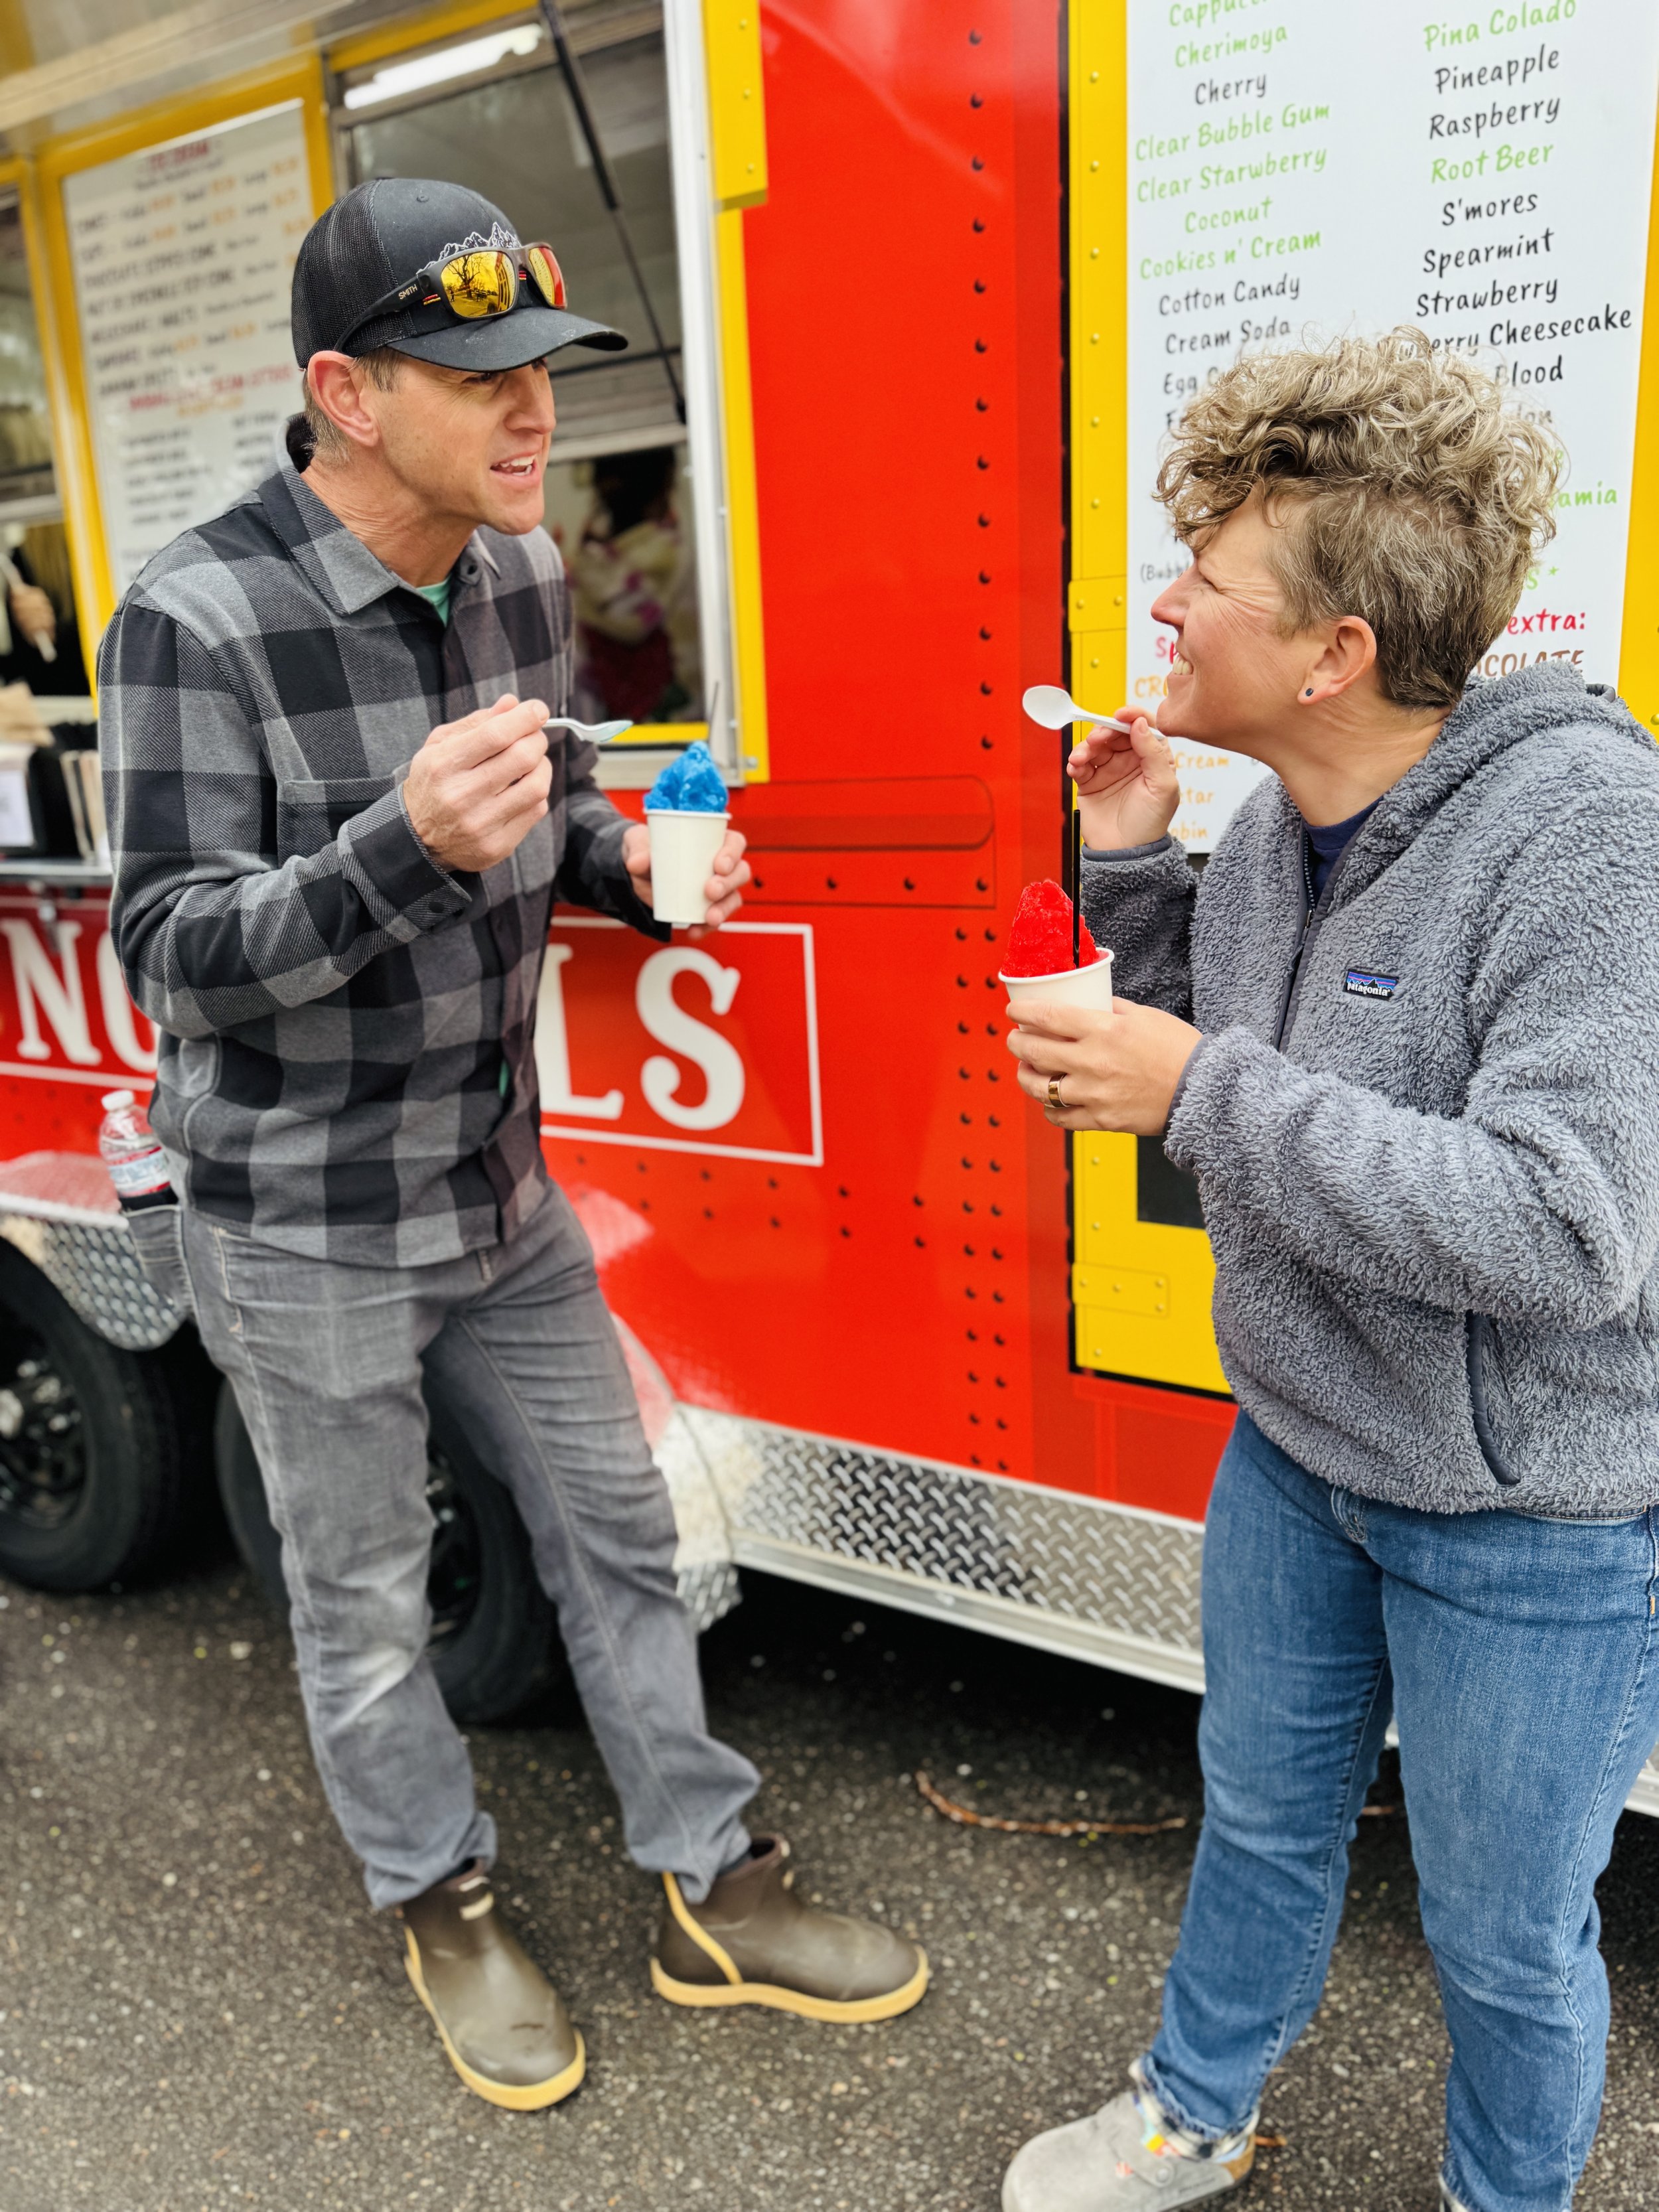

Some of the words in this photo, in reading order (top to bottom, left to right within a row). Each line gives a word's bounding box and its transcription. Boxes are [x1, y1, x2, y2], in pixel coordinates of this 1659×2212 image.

[1175, 25, 1288, 67] Cherimoya
[1423, 23, 1479, 52] Pina
[1490, 0, 1576, 35] Colado
[1435, 43, 1560, 94] Pineapple
[1195, 74, 1266, 105] Cherry
[1135, 134, 1190, 161] Clear
[1198, 110, 1272, 147] Bubble
[1281, 104, 1330, 128] Gum
[1429, 98, 1560, 139] Raspberry
[1137, 176, 1192, 202] Clear
[1200, 149, 1327, 190] Starwberry
[1431, 150, 1489, 184] Root
[1495, 143, 1554, 172] Beer
[1185, 196, 1272, 234] Coconut
[1442, 193, 1538, 226] S'mores
[1140, 250, 1216, 279] Cookies
[1251, 231, 1321, 259] Cream
[1423, 228, 1555, 278] Spearmint
[399, 283, 417, 299] SMITH
[1159, 288, 1226, 316] Cotton
[1234, 273, 1300, 300] Candy
[1416, 279, 1558, 317] Strawberry
[1165, 331, 1231, 354] Cream
[1241, 315, 1291, 344] Soda
[1489, 303, 1632, 346] Cheesecake
[1164, 373, 1197, 398] Egg
[1507, 609, 1586, 635] extra:
[1174, 751, 1230, 770] Cream
